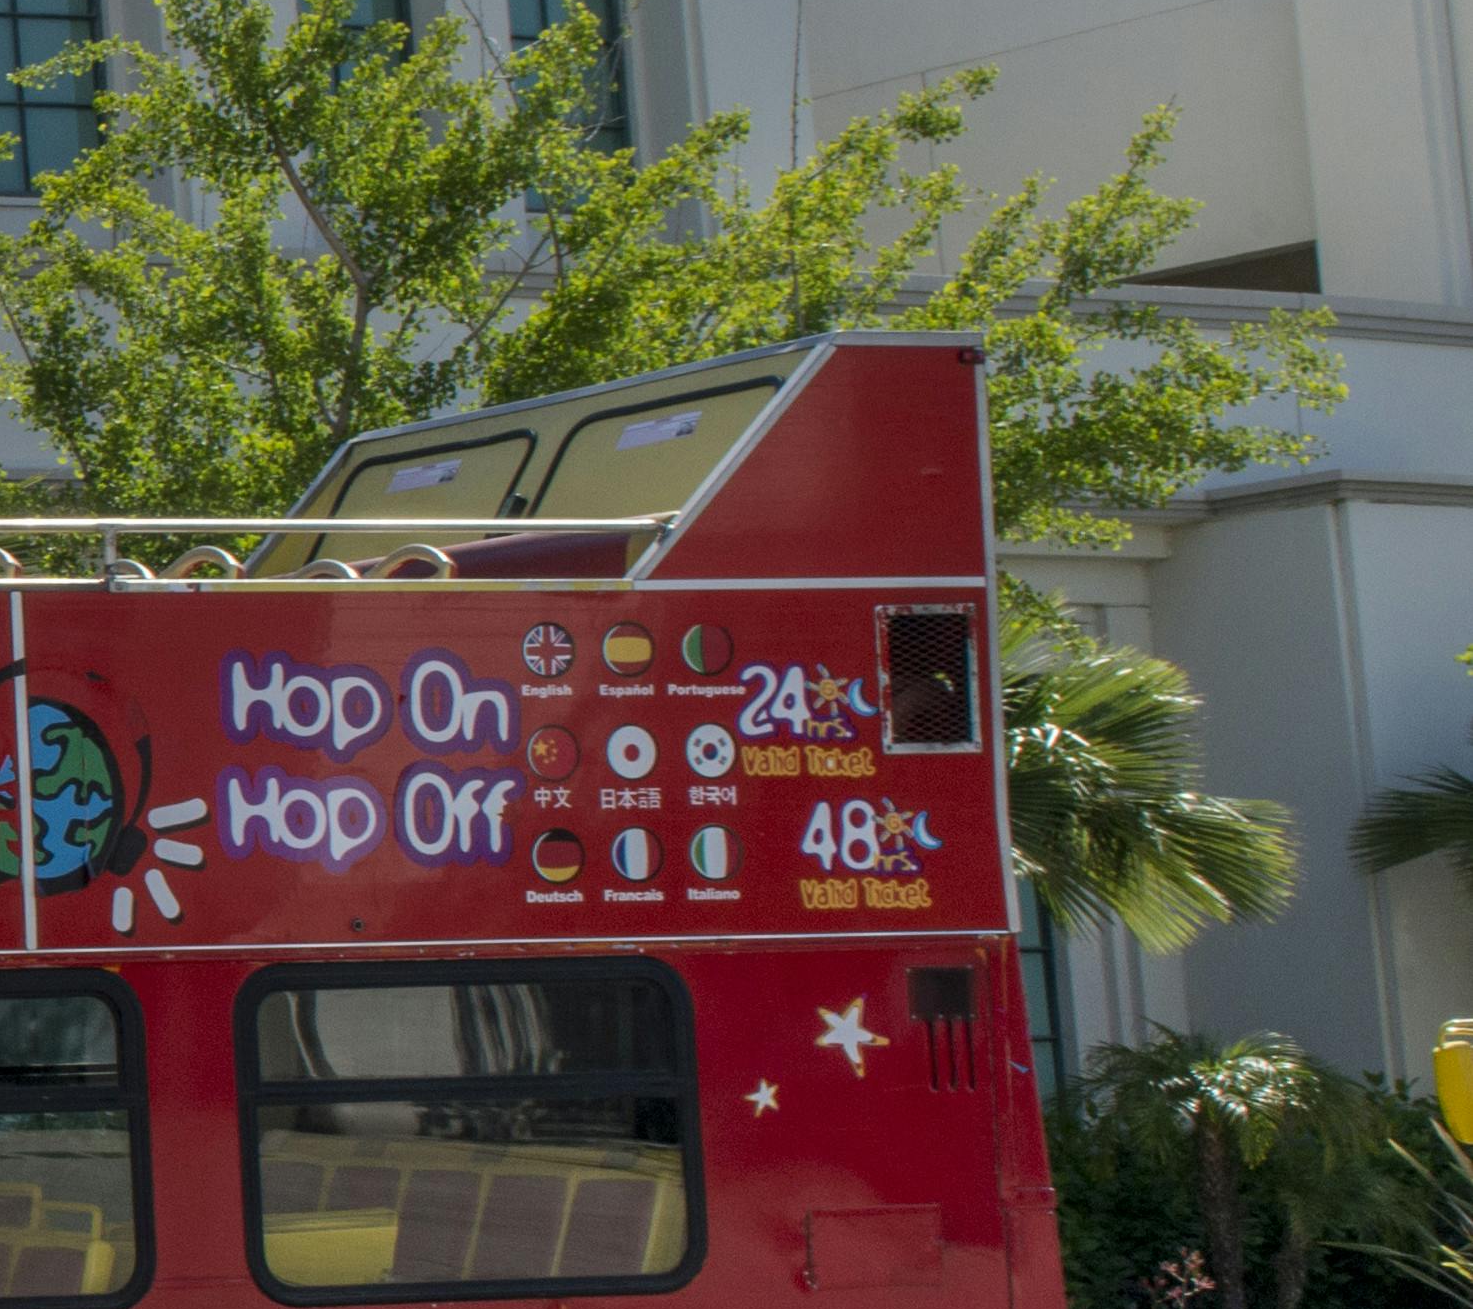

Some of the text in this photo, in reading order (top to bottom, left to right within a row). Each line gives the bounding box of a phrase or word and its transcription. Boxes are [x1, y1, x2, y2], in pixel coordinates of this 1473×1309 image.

[521, 684, 572, 698] English
[667, 684, 746, 698] Portuguese
[232, 660, 509, 750] Hop On
[741, 746, 876, 777] Valid Ticket
[534, 786, 572, 809] 中文
[600, 787, 661, 809] 日本語
[688, 785, 737, 806] 한국어
[228, 772, 515, 861] Hop Off
[526, 890, 584, 903] Deutsch
[688, 888, 741, 901] Italiano
[800, 877, 932, 909] Valid Ticket
